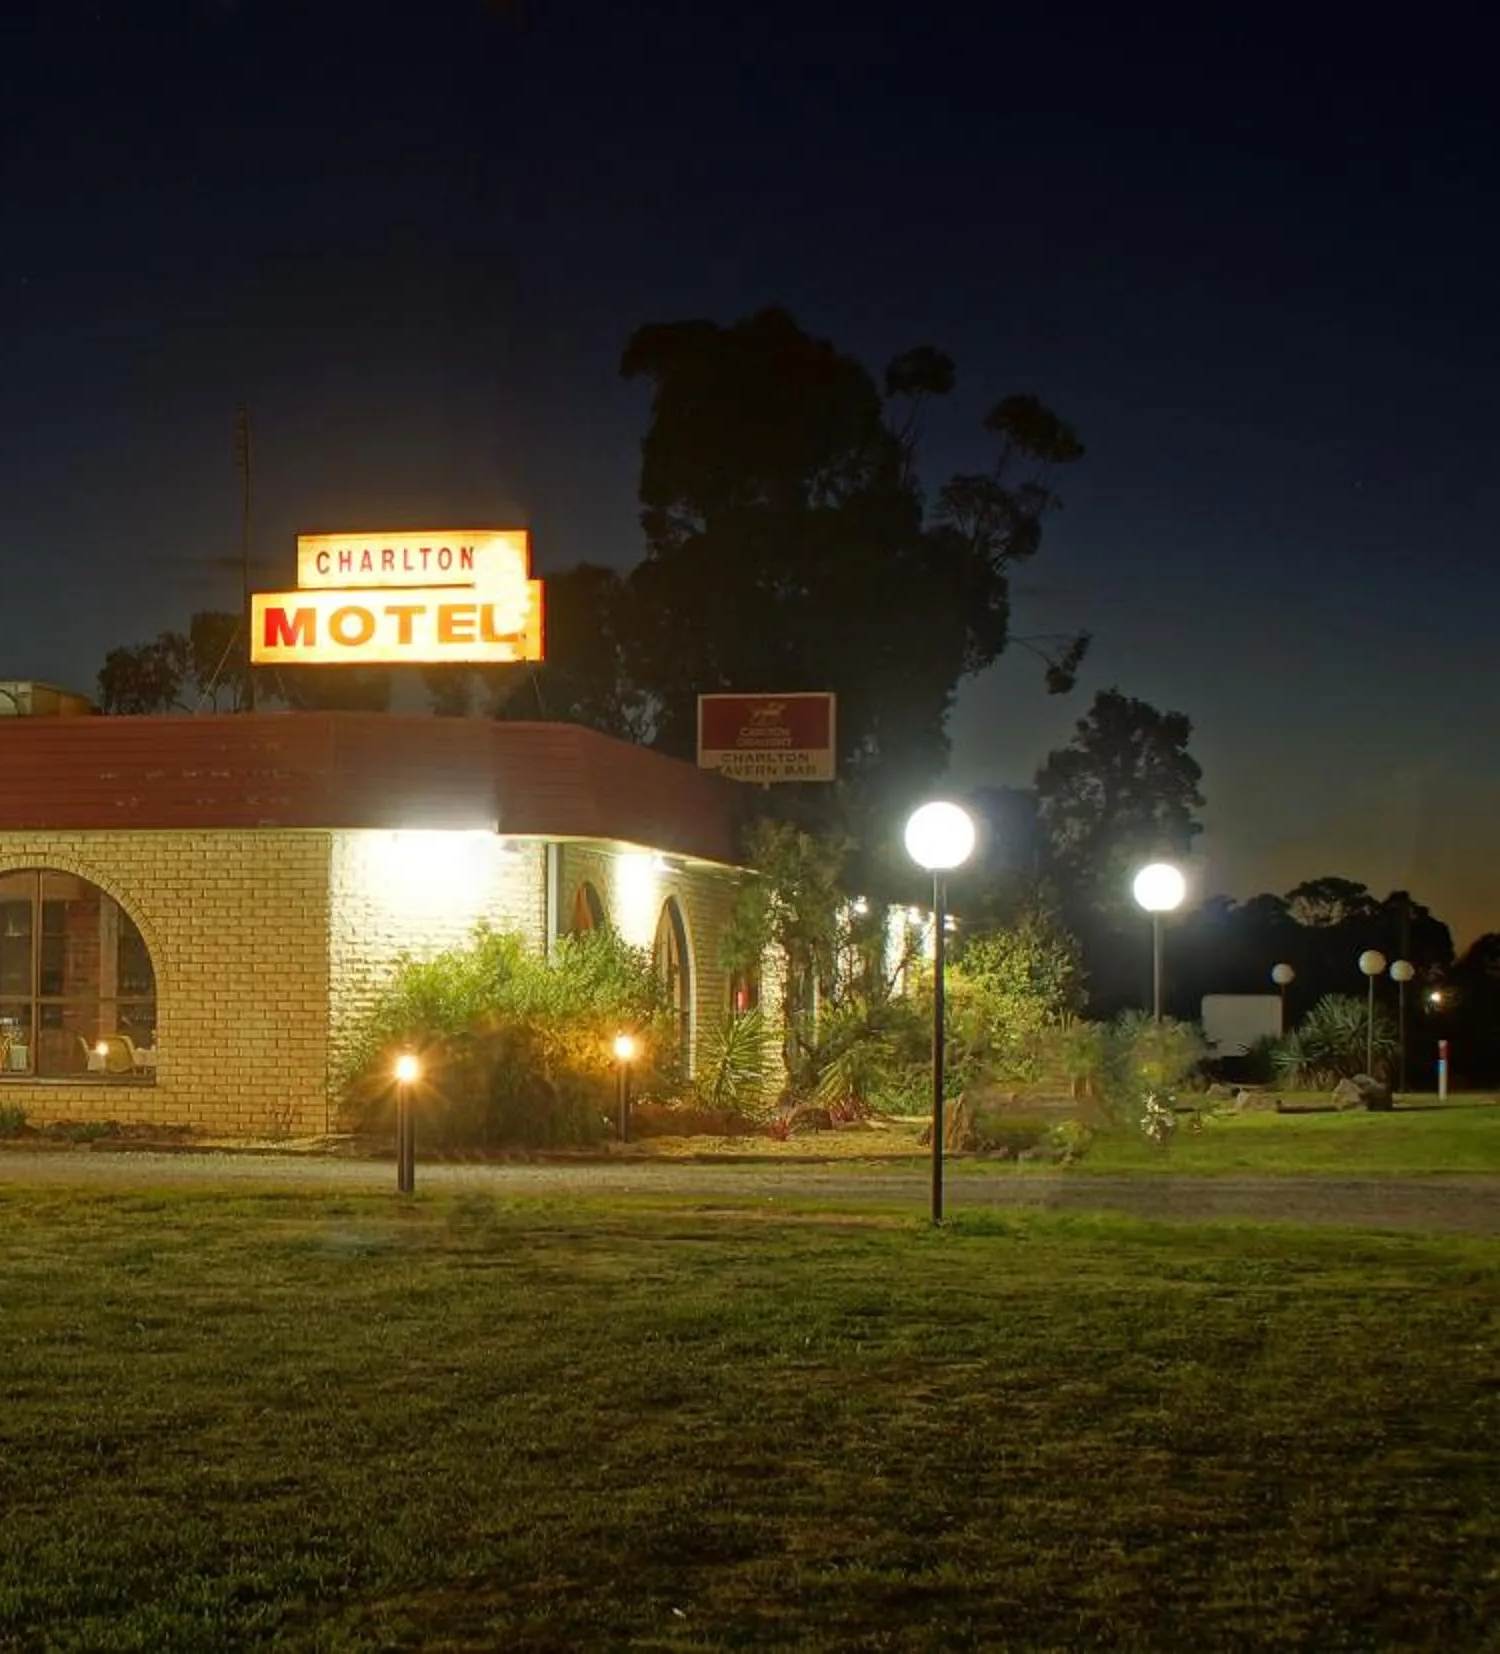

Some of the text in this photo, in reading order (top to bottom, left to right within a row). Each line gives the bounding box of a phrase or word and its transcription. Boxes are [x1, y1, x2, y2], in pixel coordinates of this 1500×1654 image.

[315, 545, 474, 574] CHARLTON
[263, 603, 519, 648] MOTEL
[722, 752, 809, 763] CHARLTON
[719, 764, 777, 775] AVERN
